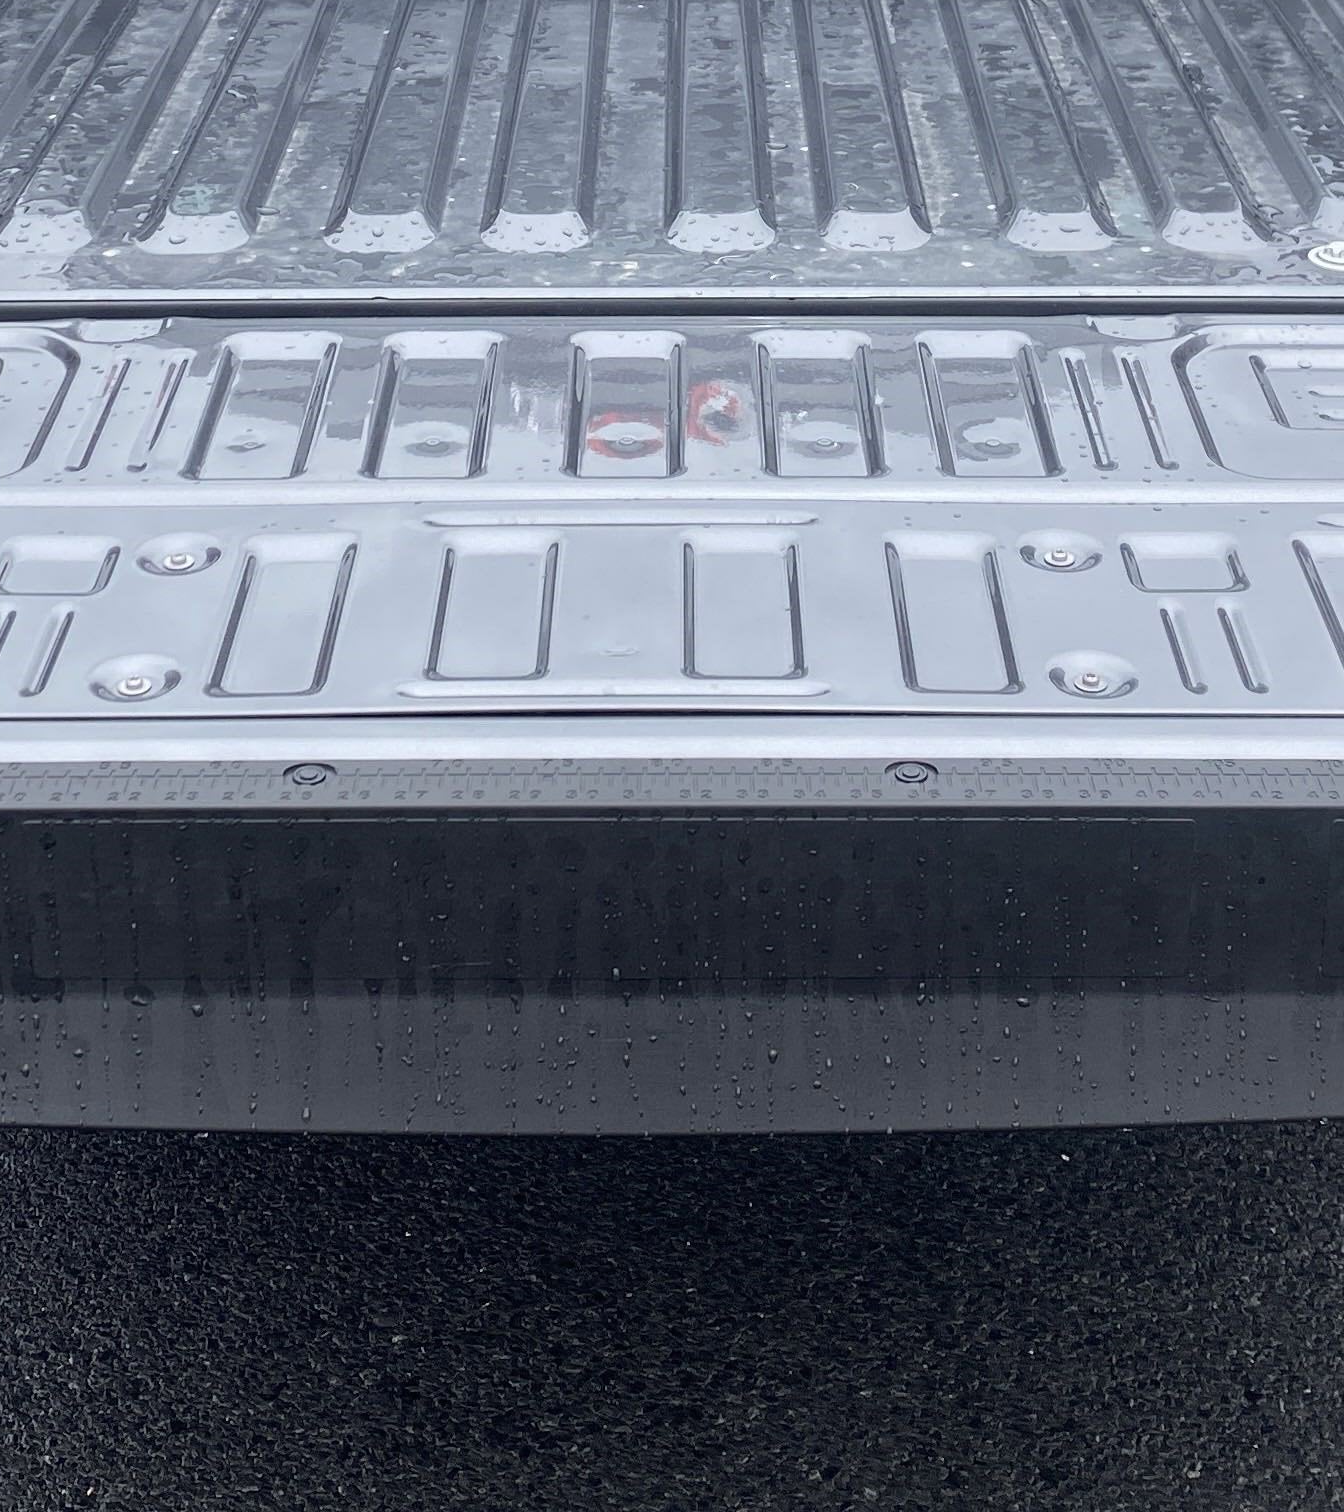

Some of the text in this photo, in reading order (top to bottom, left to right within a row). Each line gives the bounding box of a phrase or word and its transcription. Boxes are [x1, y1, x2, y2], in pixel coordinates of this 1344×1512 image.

[49, 792, 81, 801] 21
[107, 792, 142, 801] 22
[164, 792, 200, 801] 23
[222, 792, 257, 801] 24
[280, 791, 313, 801] 25
[394, 790, 429, 800] 27
[451, 790, 485, 799] 28
[508, 790, 542, 799] 29
[565, 790, 599, 799] 30
[679, 789, 713, 799] 32
[736, 789, 769, 799] 33
[793, 789, 827, 798] 34
[850, 789, 883, 798] 35
[964, 789, 997, 798] 37
[1135, 789, 1169, 799] 40
[1192, 790, 1223, 799] 41
[1250, 790, 1284, 800] 42
